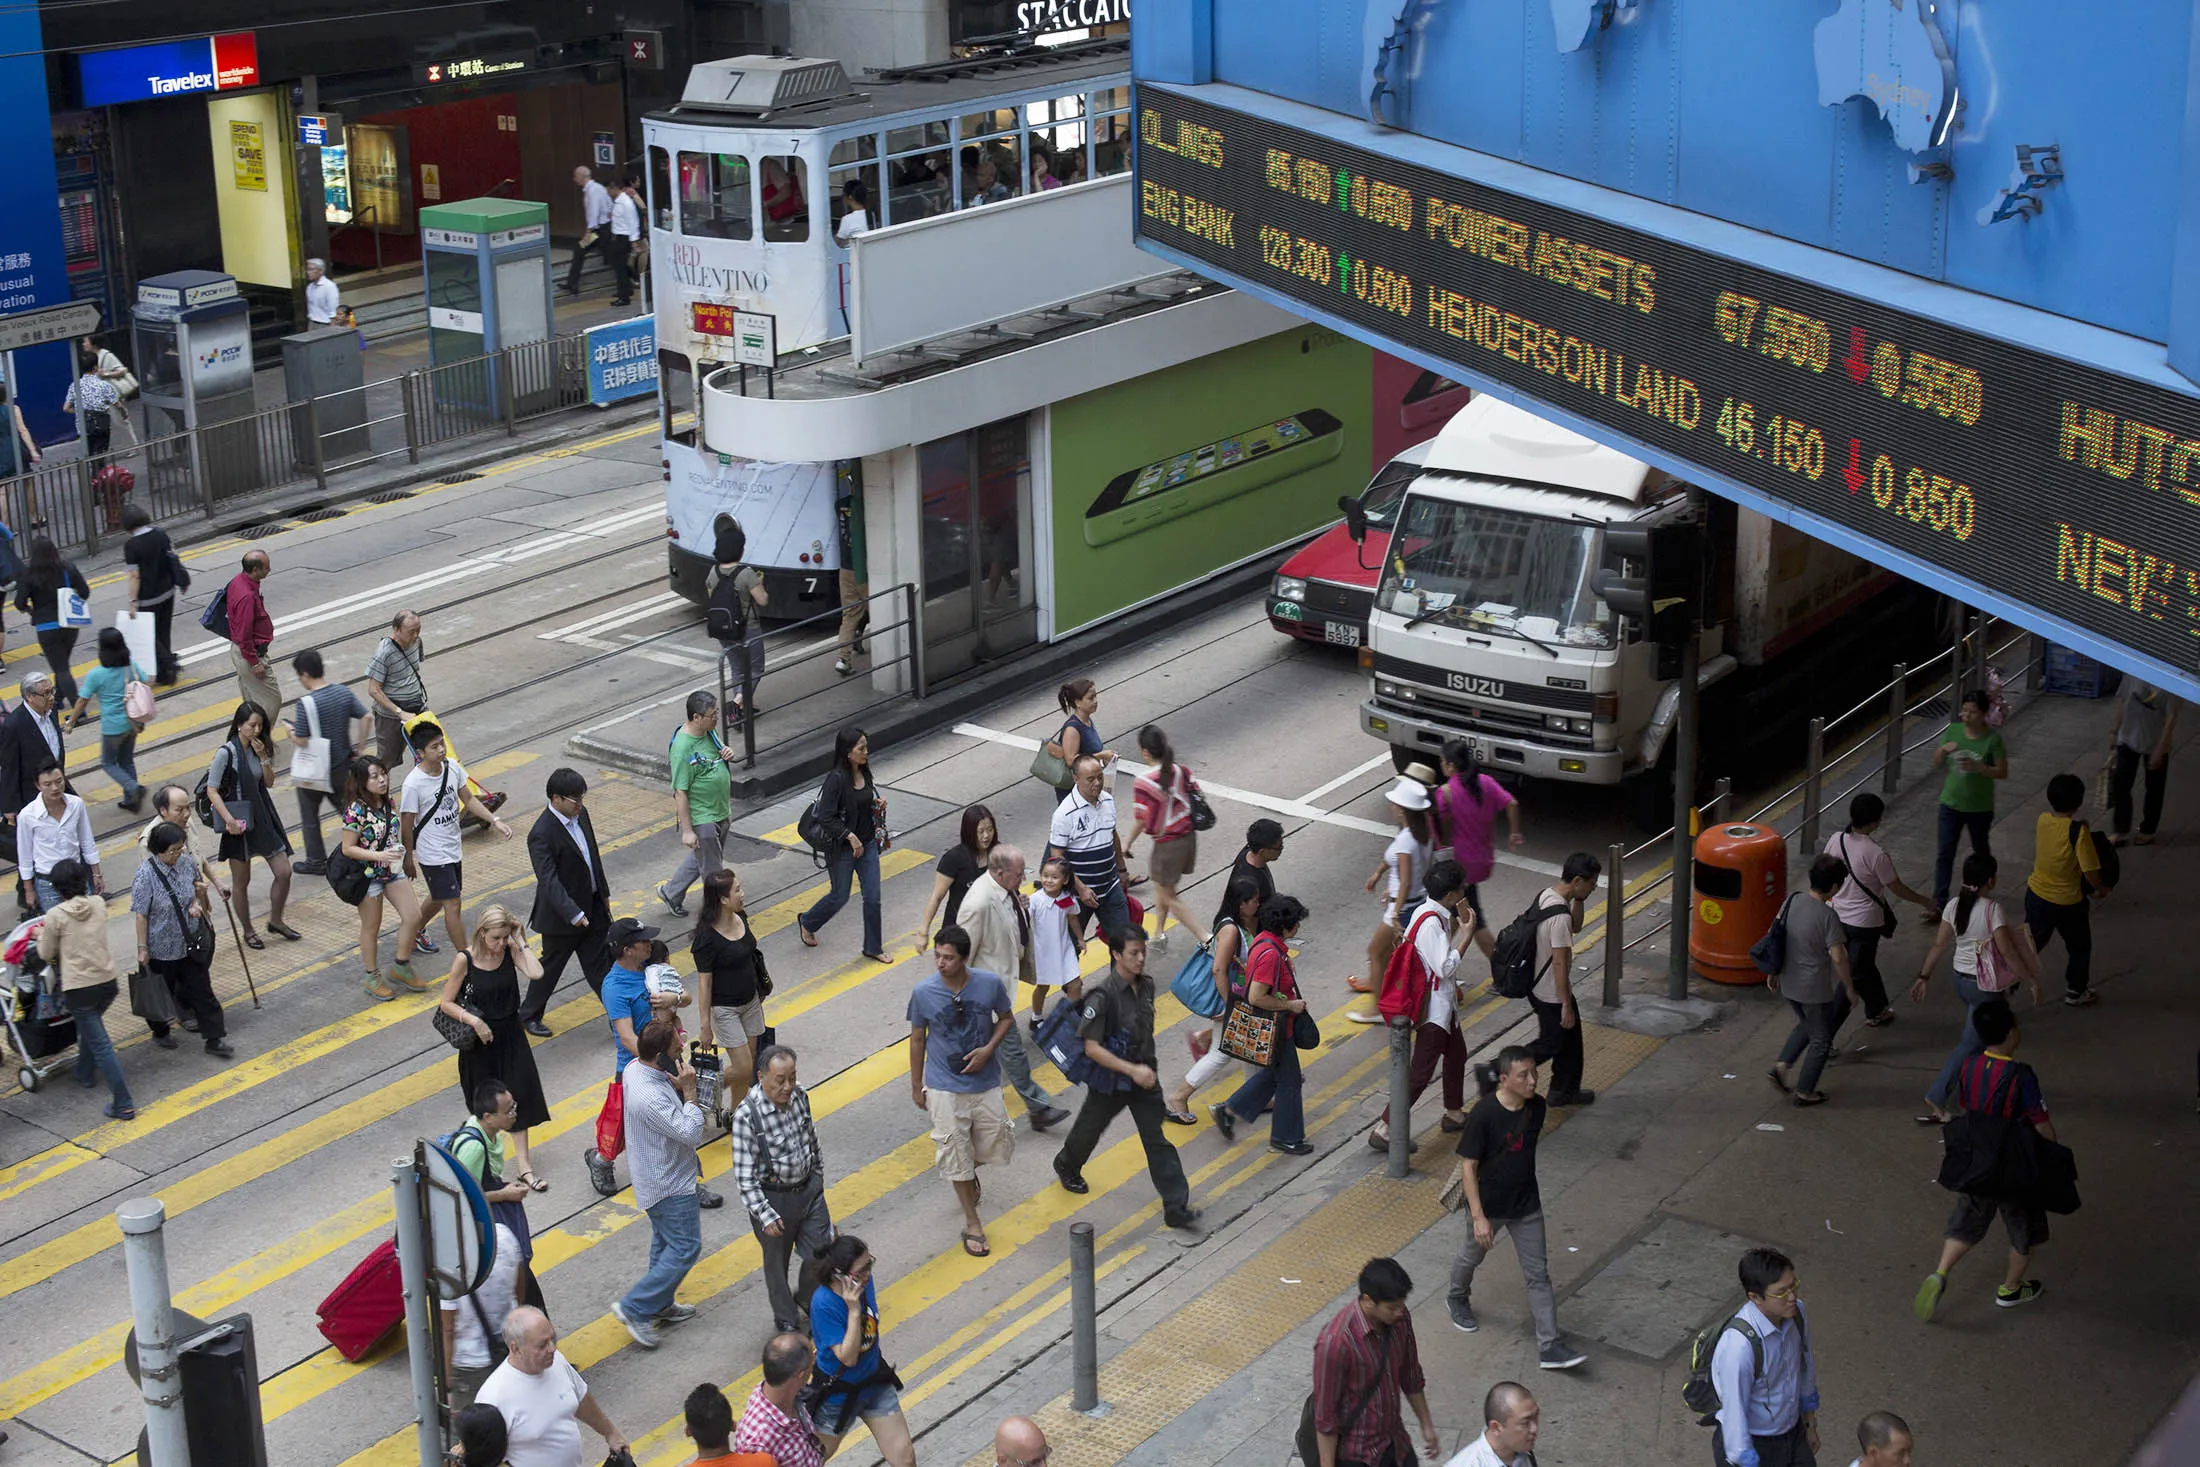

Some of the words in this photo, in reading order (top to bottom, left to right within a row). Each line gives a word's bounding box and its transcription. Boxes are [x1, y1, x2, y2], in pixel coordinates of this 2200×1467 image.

[219, 66, 254, 77] worldwide
[447, 59, 484, 78] 中環站
[148, 71, 213, 94] Travelex
[220, 75, 243, 84] money
[726, 71, 746, 100] 7
[651, 129, 656, 142] 7
[238, 147, 263, 160] SAVE
[791, 139, 800, 153] 7
[673, 243, 701, 267] RED
[1426, 197, 1530, 272] POWER
[1533, 230, 1657, 315] ASSETS
[673, 262, 768, 293] VALENTINO
[695, 304, 718, 317] North
[221, 346, 241, 355] PCCW
[1185, 194, 1236, 250] BANK
[1428, 284, 1607, 395] HENDERSON
[1615, 353, 1701, 431] LAND
[1715, 397, 1825, 481] 46.150
[1872, 453, 1977, 542] 0.850
[805, 577, 817, 593] 7
[1335, 624, 1350, 634] KN
[1327, 632, 1358, 646] 5997
[1447, 673, 1504, 697] ISUZU
